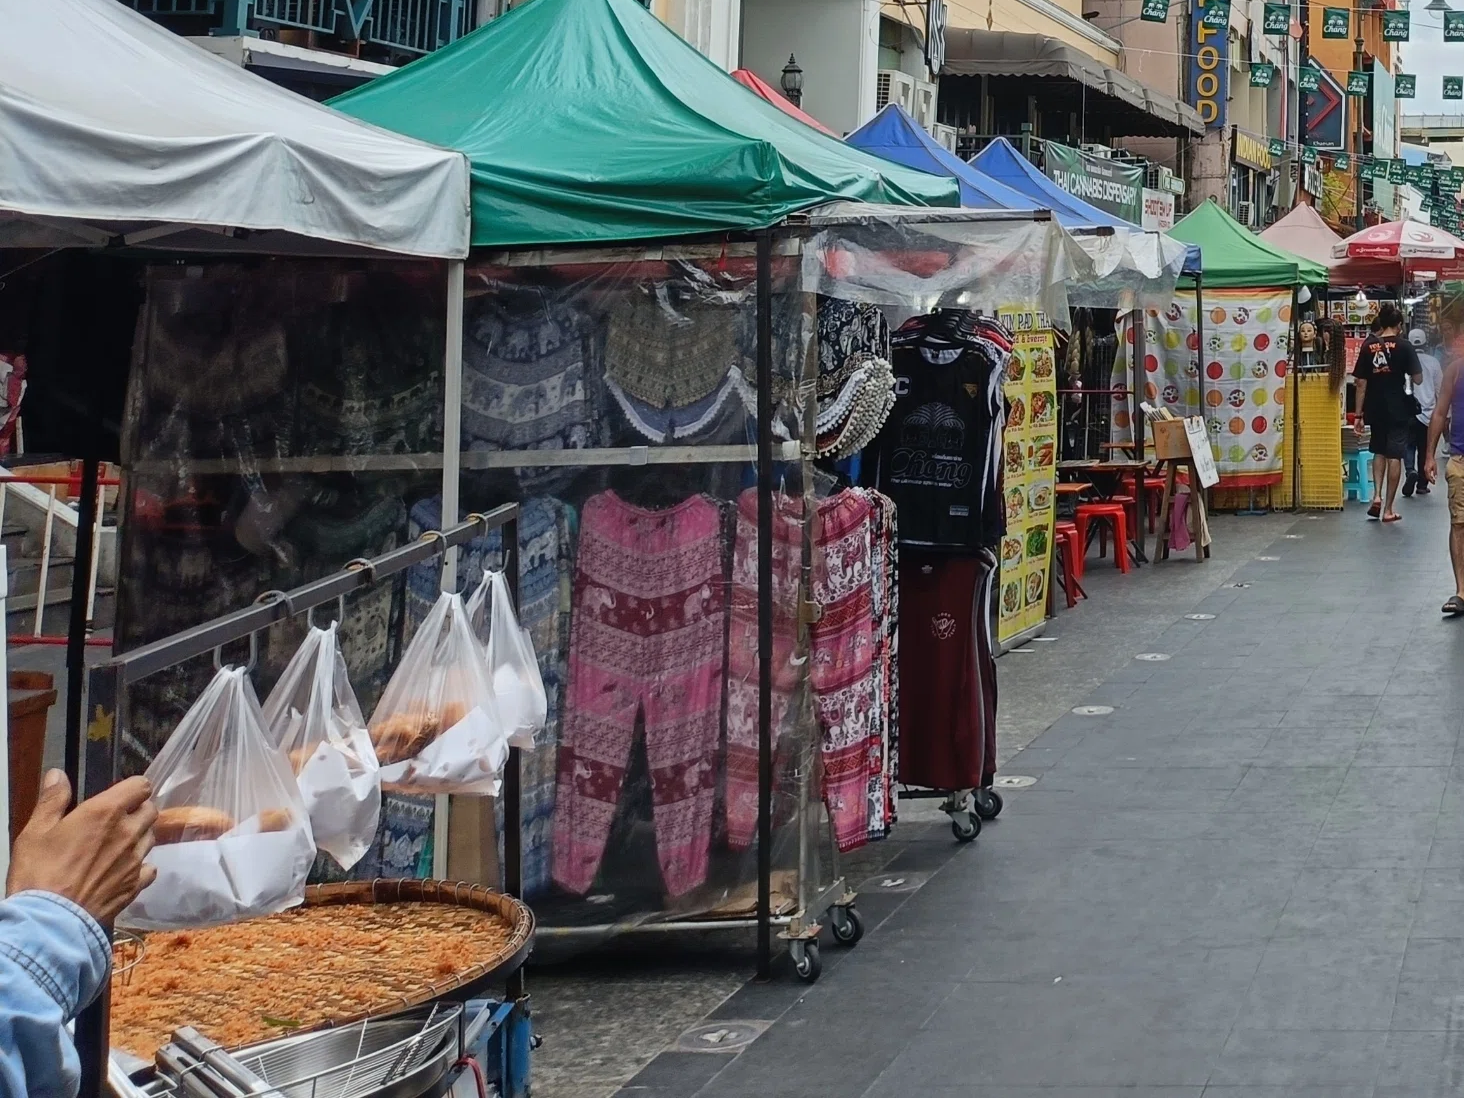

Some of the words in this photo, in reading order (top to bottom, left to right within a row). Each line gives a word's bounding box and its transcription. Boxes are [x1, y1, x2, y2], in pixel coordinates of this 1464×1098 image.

[1143, 8, 1165, 18] Chang
[1204, 15, 1227, 25] Chang
[1265, 21, 1288, 30] Chang
[1324, 25, 1347, 34] Chang
[1384, 29, 1407, 37] Chang
[1236, 131, 1257, 164] INDIAN
[1053, 169, 1070, 194] THAI
[1069, 173, 1103, 199] CANNABIS
[1103, 180, 1138, 206] DISPENSARY
[1017, 312, 1033, 330] PAD
[895, 376, 910, 395] C
[890, 447, 973, 489] Chang
